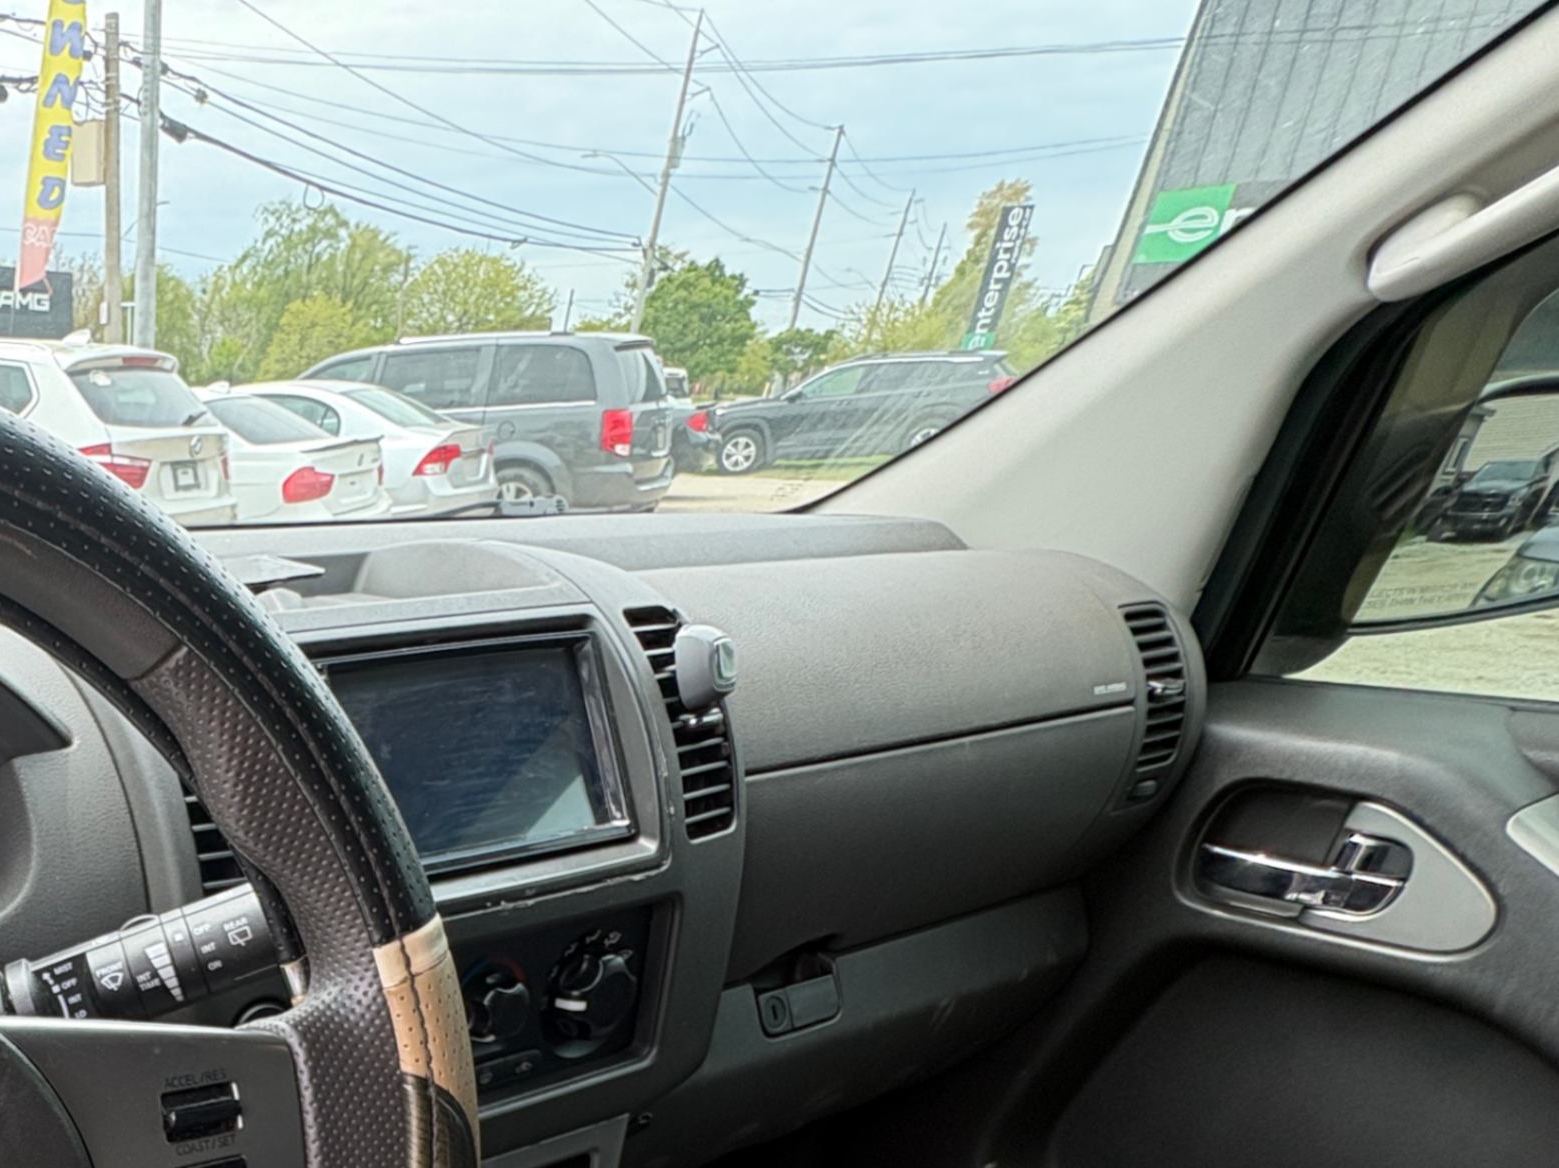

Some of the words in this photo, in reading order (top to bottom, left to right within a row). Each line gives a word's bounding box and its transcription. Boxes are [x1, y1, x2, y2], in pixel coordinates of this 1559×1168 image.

[38, 0, 86, 210] WNED
[968, 206, 1025, 350] enterprise
[192, 923, 212, 936] OFF
[200, 941, 217, 955] INT
[53, 961, 74, 976] MIST
[95, 960, 123, 978] FRONT
[207, 959, 223, 971] ON
[61, 977, 78, 991] OFF
[136, 970, 152, 984] INT
[139, 976, 162, 992] TIME
[67, 993, 83, 1006] INT
[164, 1067, 228, 1091] ACCEL/RES
[175, 1132, 237, 1156] COAST/SET
